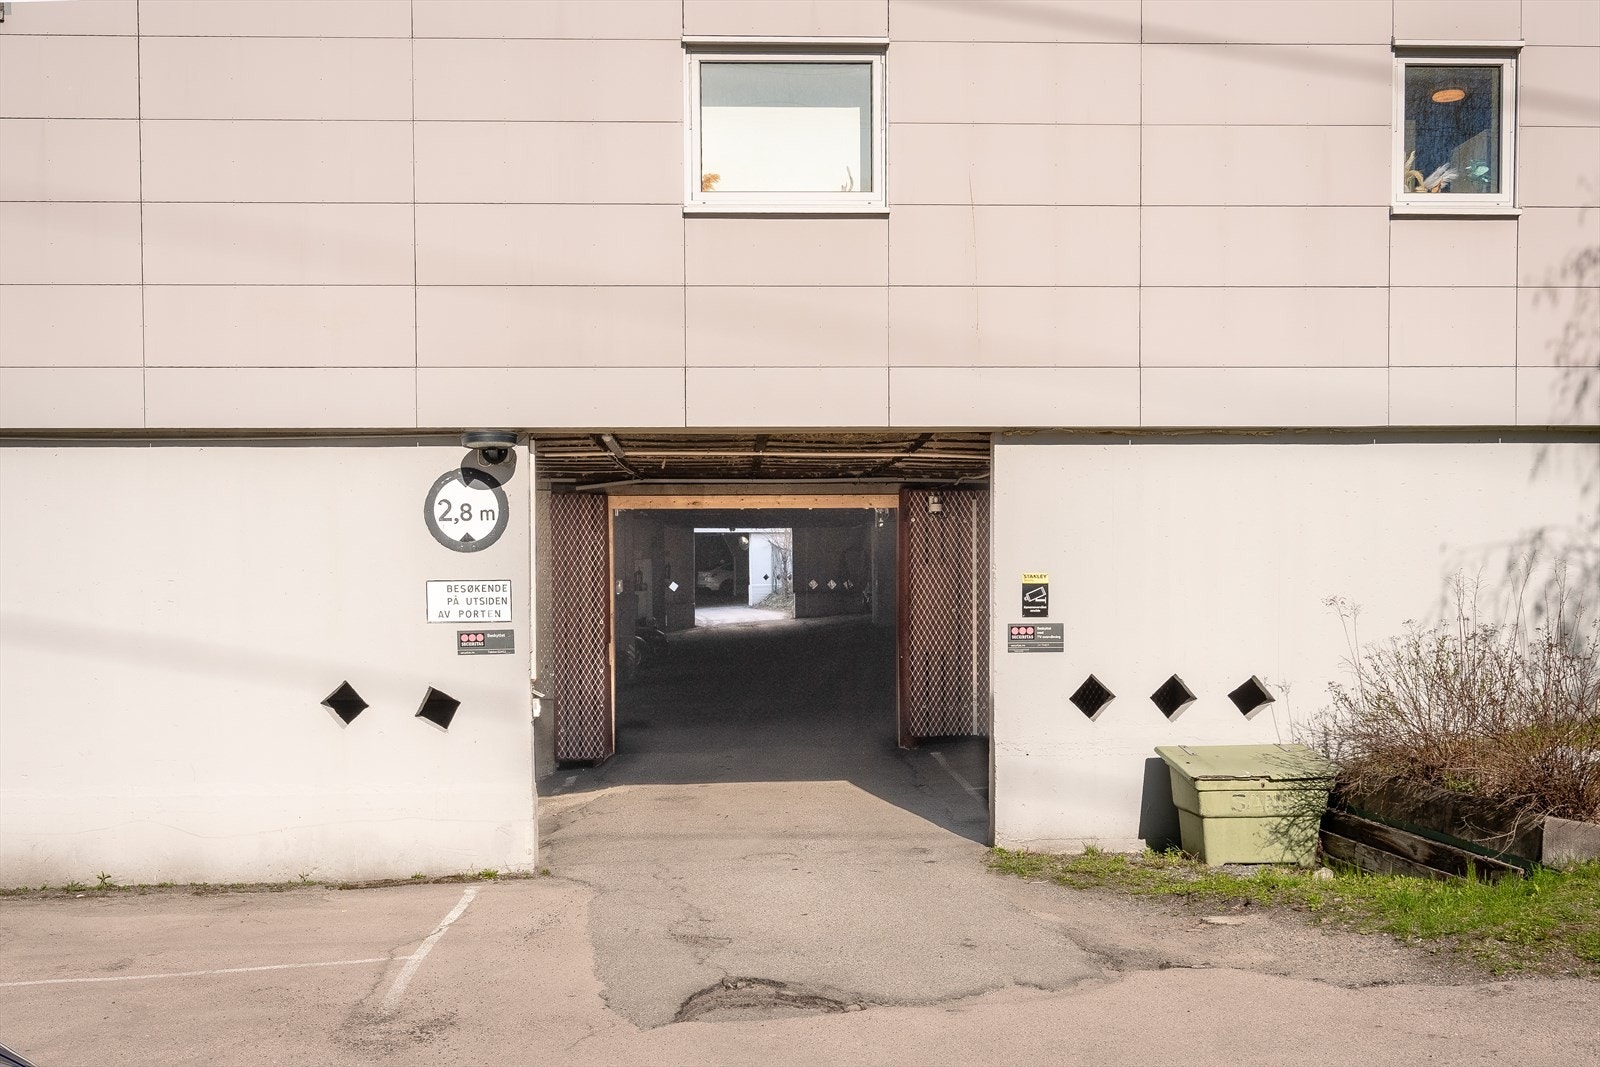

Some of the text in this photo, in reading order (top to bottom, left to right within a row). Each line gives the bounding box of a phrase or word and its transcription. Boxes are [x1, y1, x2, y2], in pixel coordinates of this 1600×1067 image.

[438, 499, 495, 524] 2,8 m
[446, 584, 508, 593] BESØKENDE
[447, 595, 508, 605] PÅ UTSIDEN
[438, 610, 501, 618] AV PORTEN
